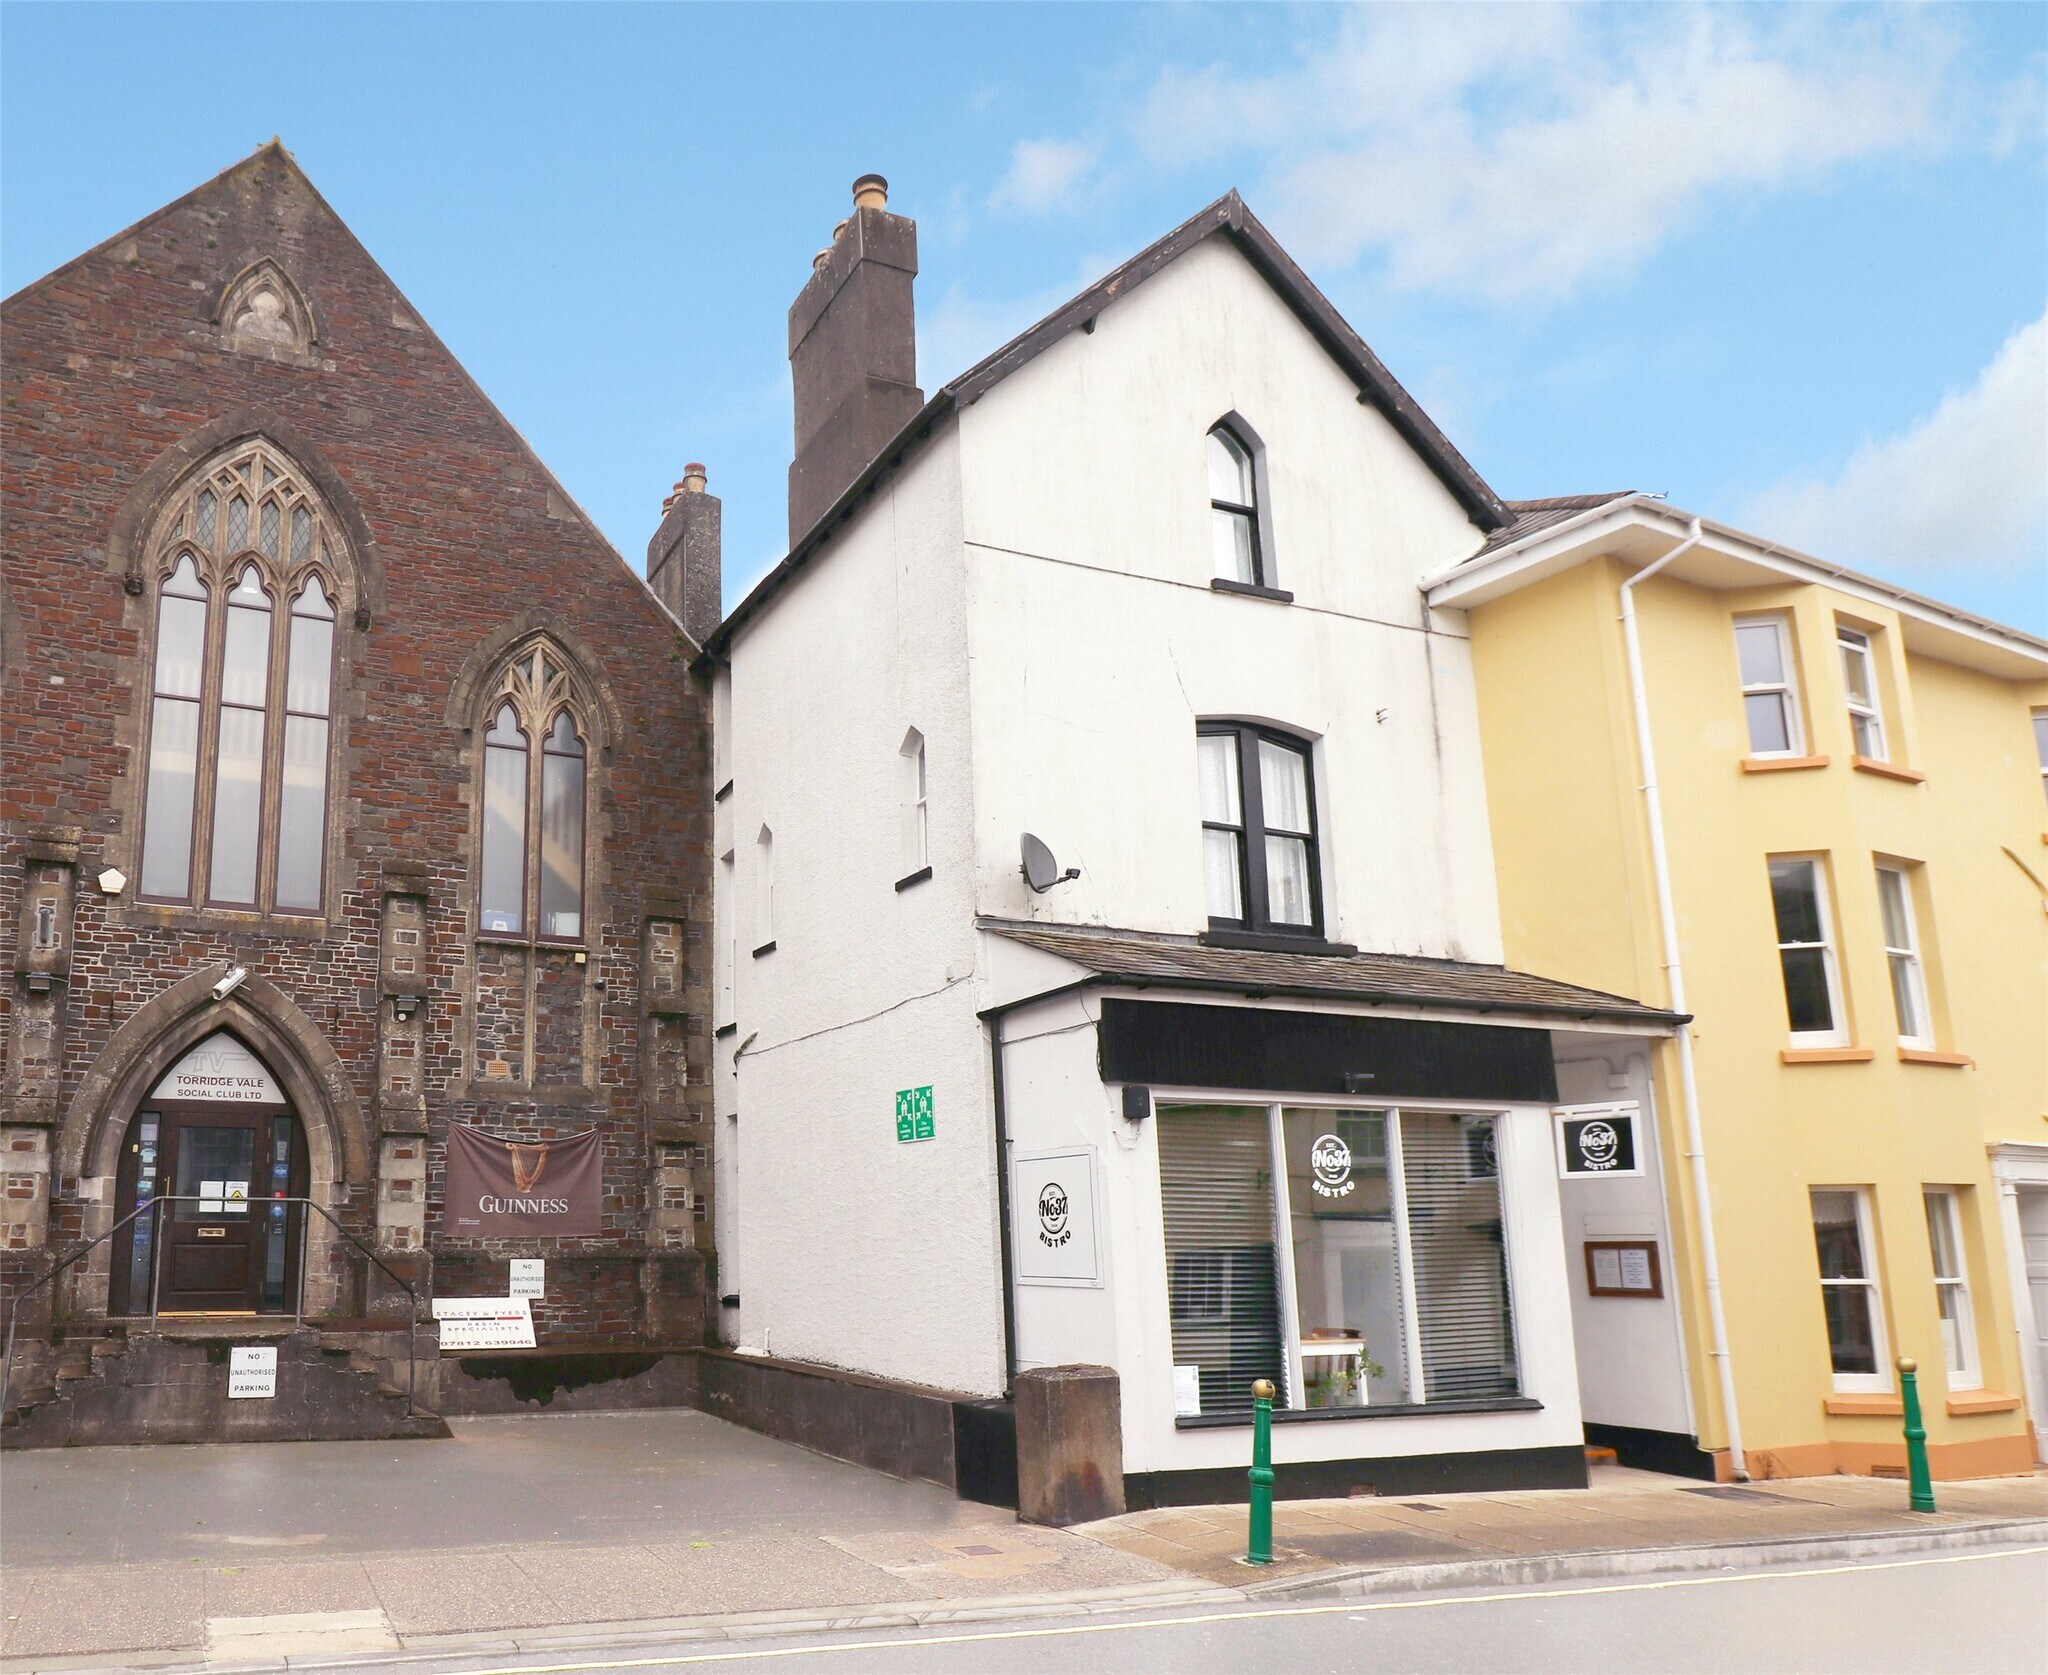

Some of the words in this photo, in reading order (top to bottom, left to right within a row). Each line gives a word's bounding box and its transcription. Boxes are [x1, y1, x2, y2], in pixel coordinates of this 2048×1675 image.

[176, 1075, 234, 1087] TORRIDGE
[236, 1078, 265, 1088] VALE
[177, 1088, 213, 1098] SOCIAL
[216, 1089, 242, 1099] CLUB
[244, 1091, 262, 1100] LTD
[1311, 1149, 1351, 1168] No37
[1584, 1158, 1618, 1171] BISTRO
[1311, 1179, 1355, 1198] BISTRO
[1039, 1196, 1068, 1217] No37
[1039, 1230, 1071, 1248] BISTRO
[230, 1368, 276, 1376] UNAUTHORISED
[234, 1384, 270, 1392] PARKING
